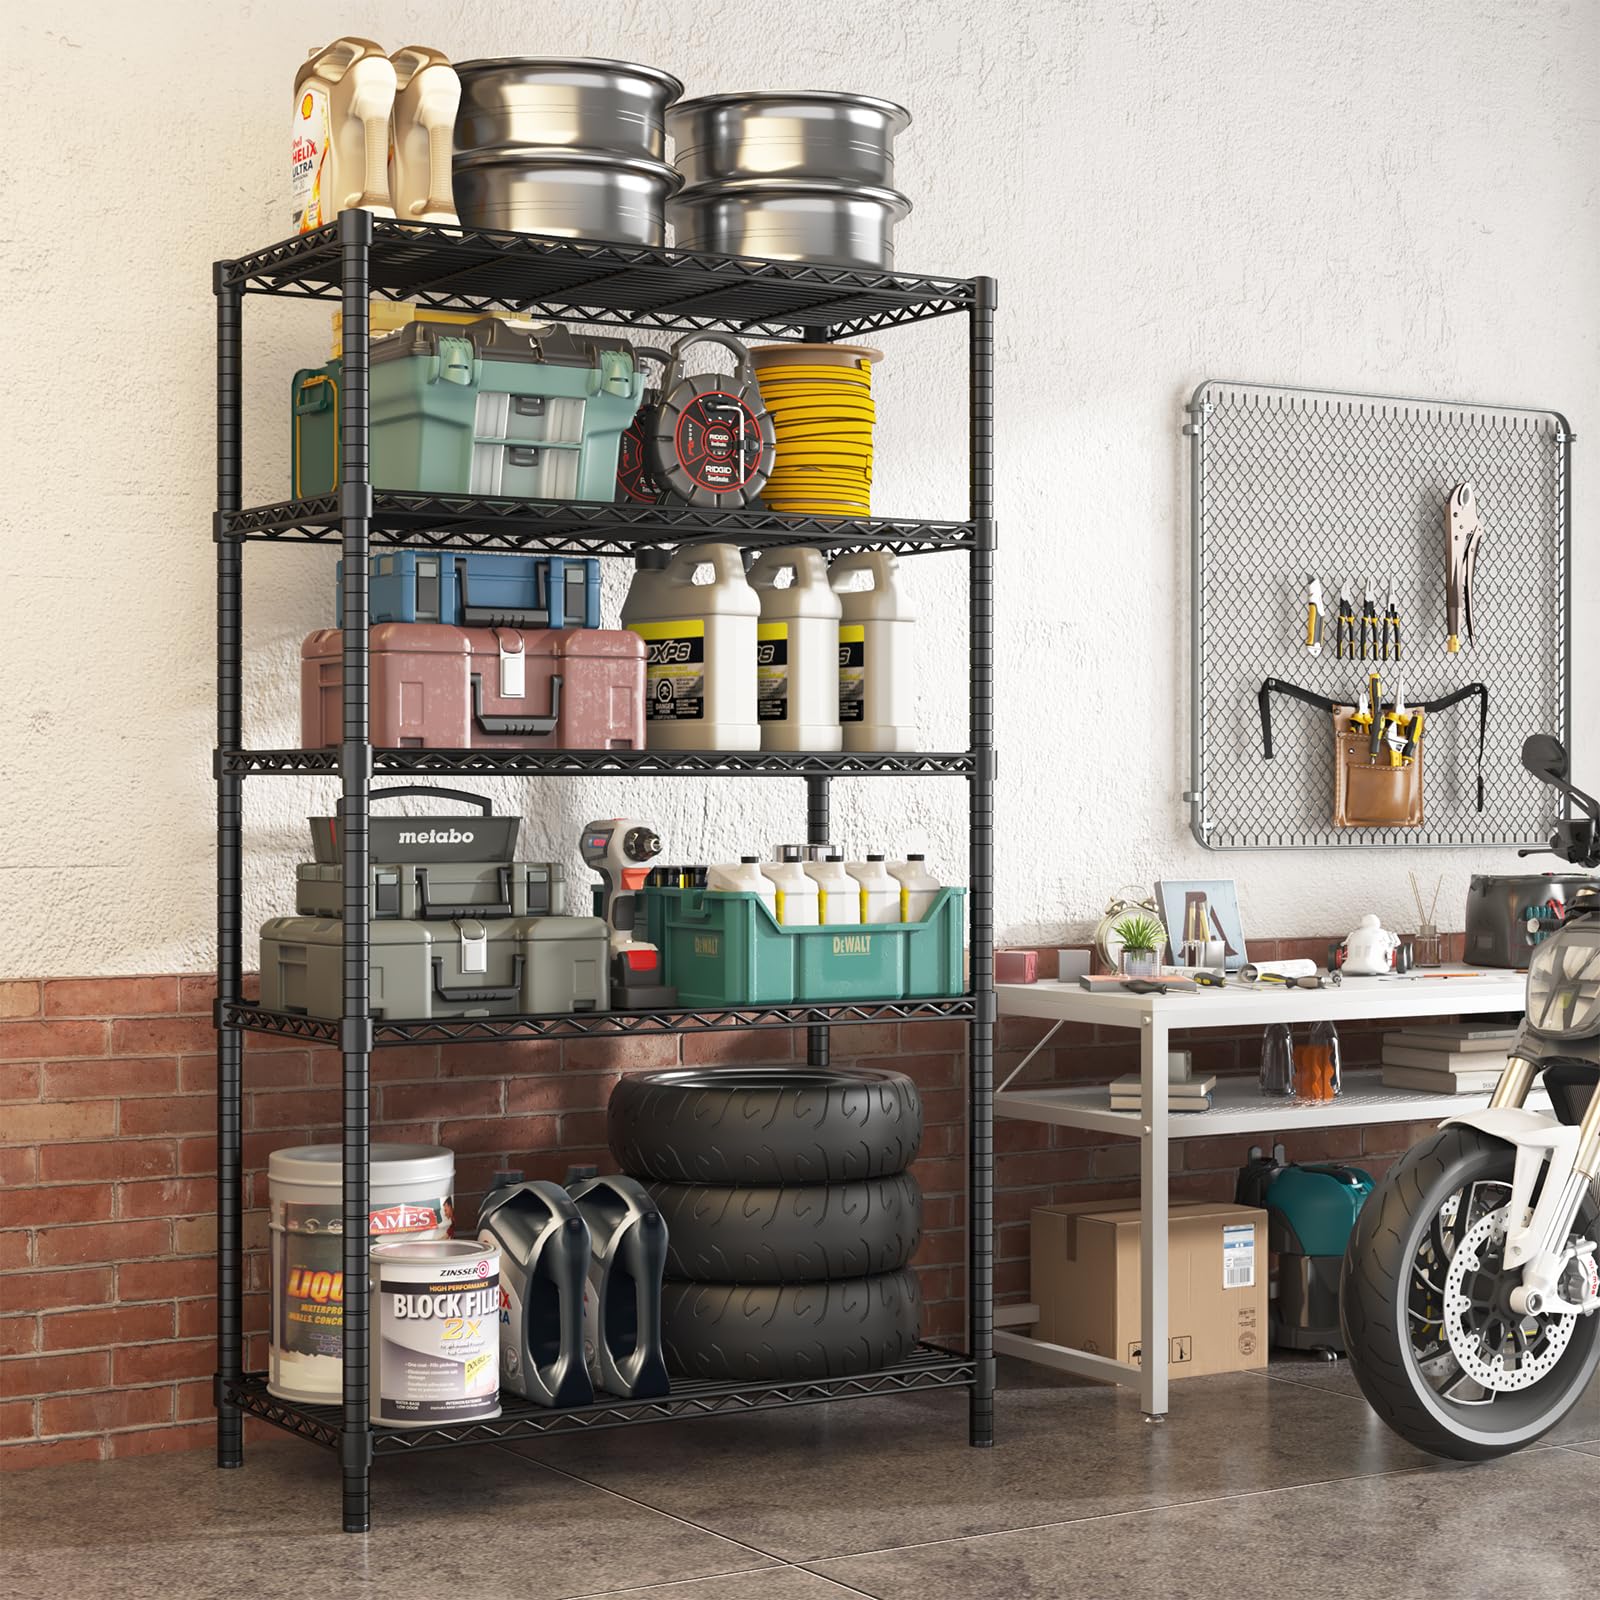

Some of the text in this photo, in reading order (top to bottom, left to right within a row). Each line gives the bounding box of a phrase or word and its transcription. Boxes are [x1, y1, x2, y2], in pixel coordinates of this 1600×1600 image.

[292, 140, 317, 165] HELIX
[705, 465, 732, 474] RIDGID
[398, 828, 474, 844] metabo
[370, 1211, 430, 1230] AMES
[440, 1267, 479, 1277] ZINSSER
[429, 1284, 447, 1292] HIGH
[393, 1293, 462, 1318] BLOCK
